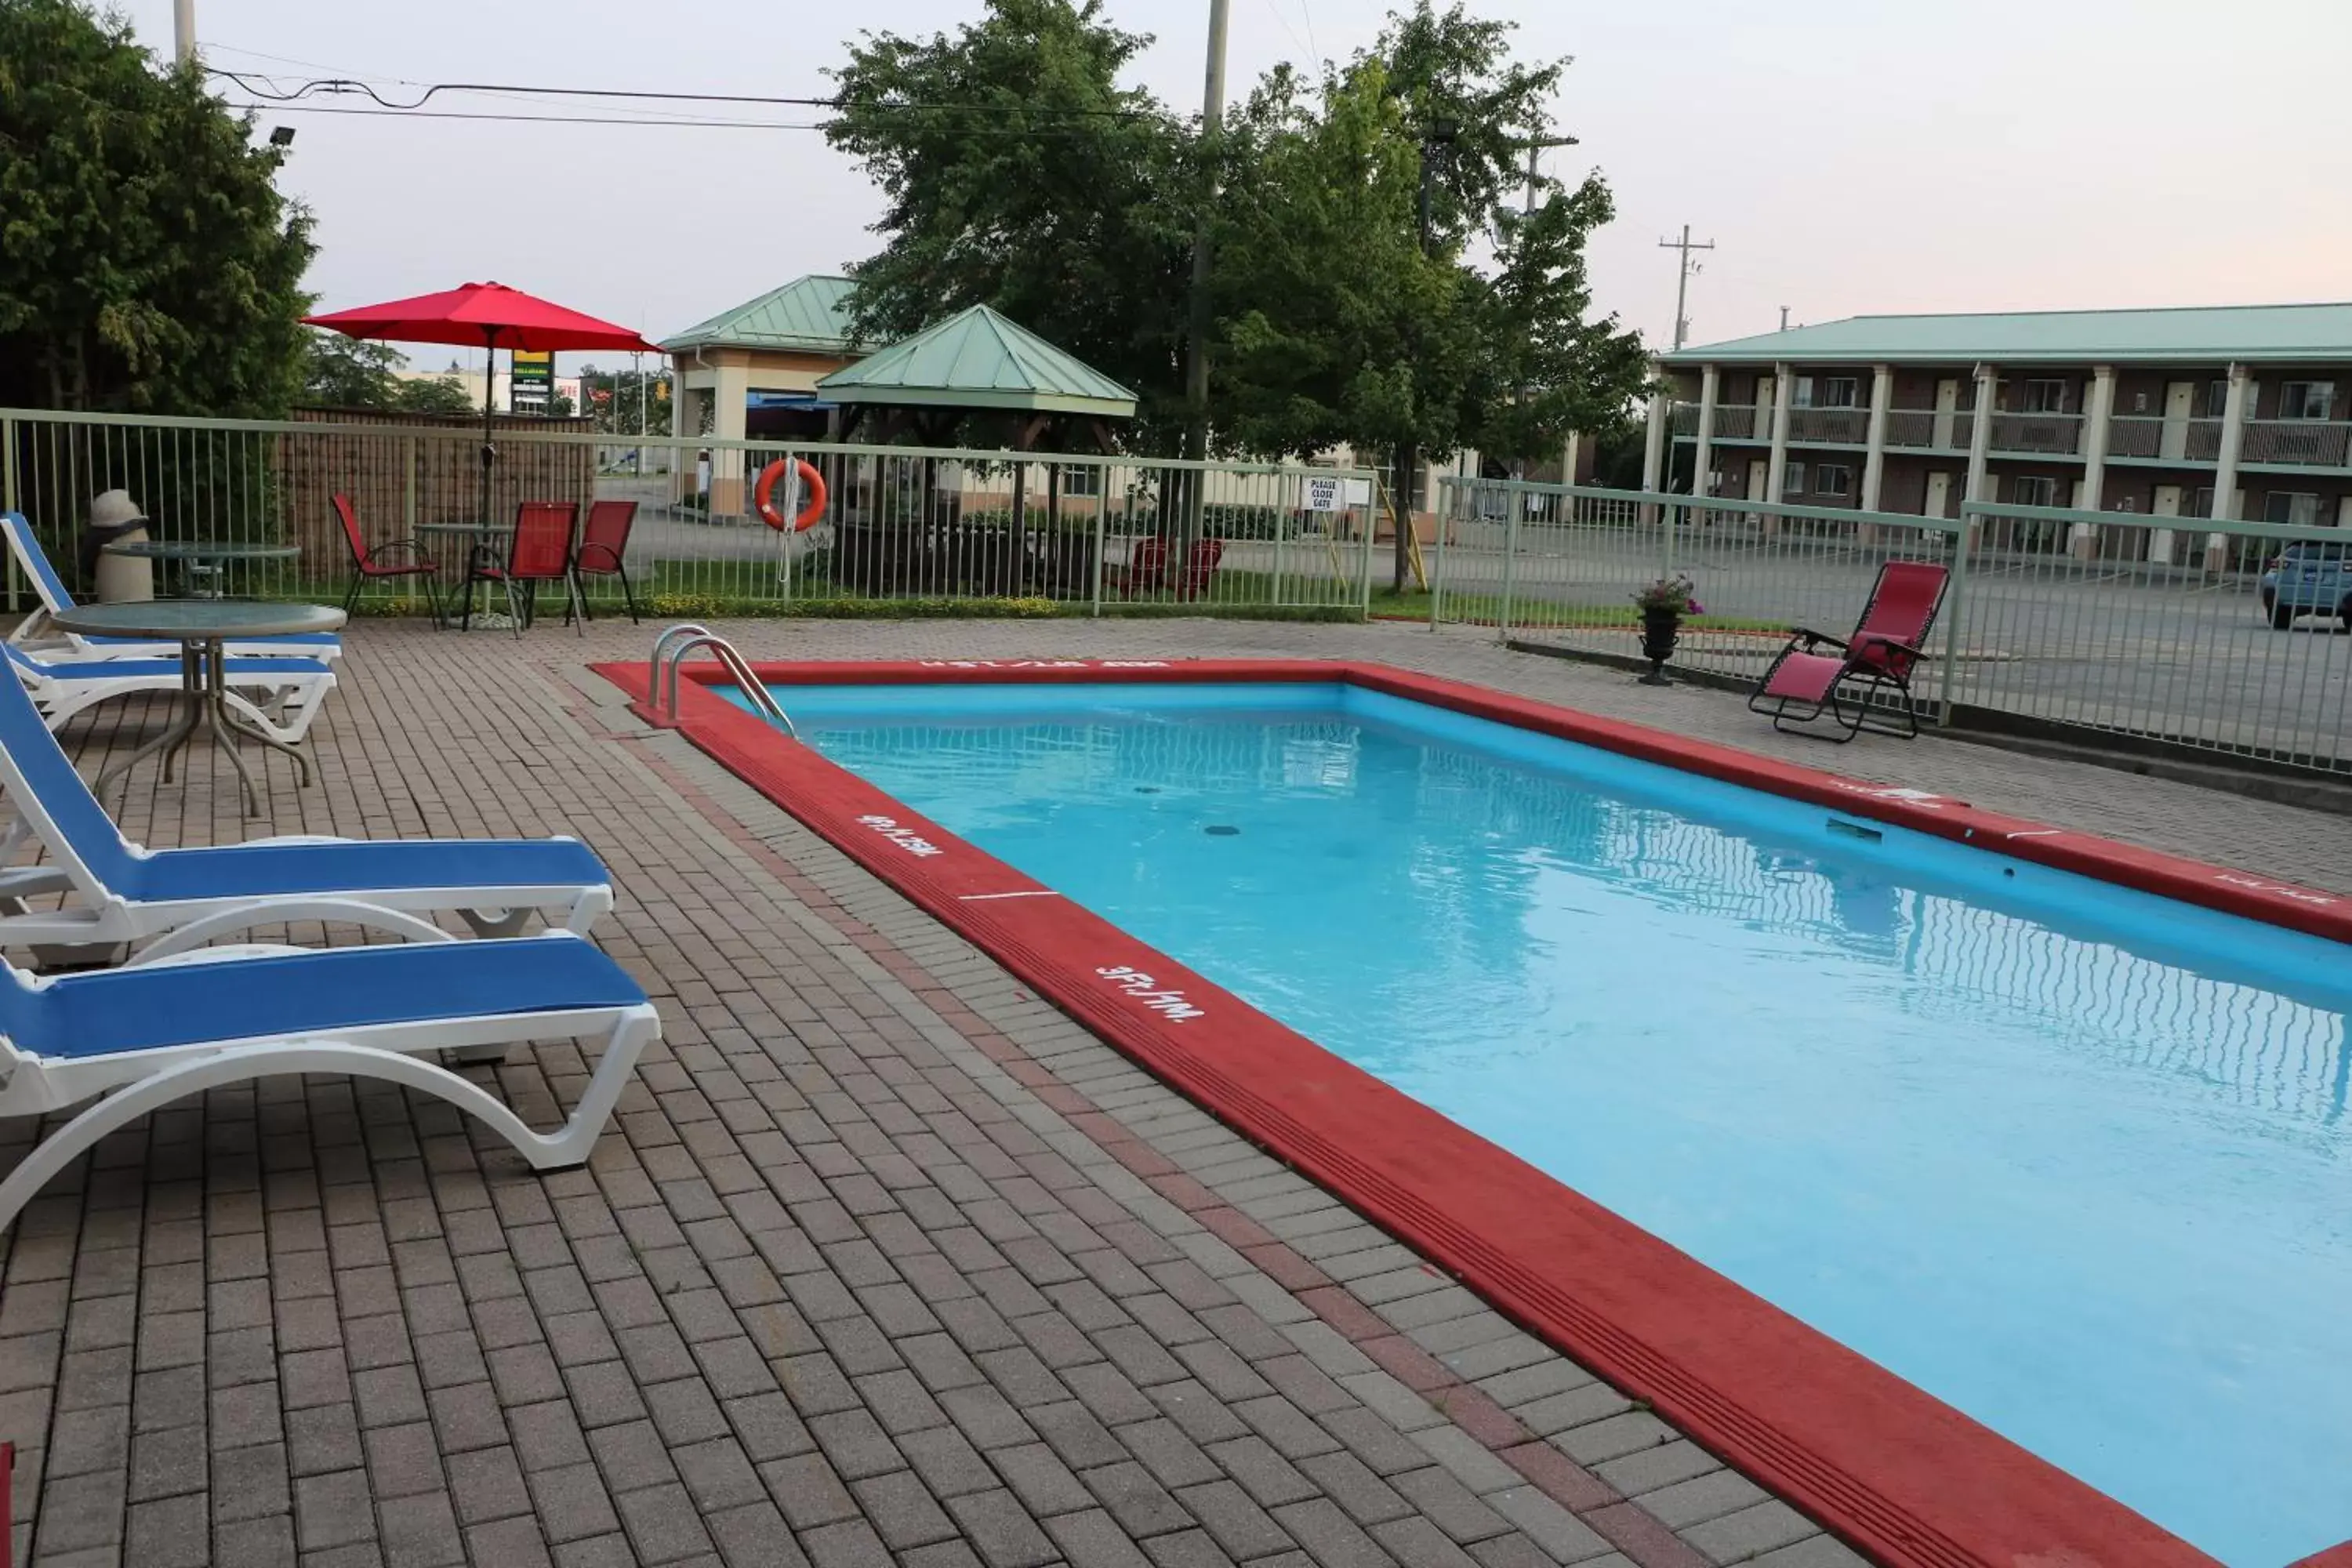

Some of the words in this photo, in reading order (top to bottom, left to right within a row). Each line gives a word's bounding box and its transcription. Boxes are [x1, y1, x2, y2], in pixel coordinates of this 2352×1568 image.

[1310, 479, 1337, 490] PLEASE
[1312, 489, 1334, 499] CLOSE
[1313, 499, 1330, 509] GATE
